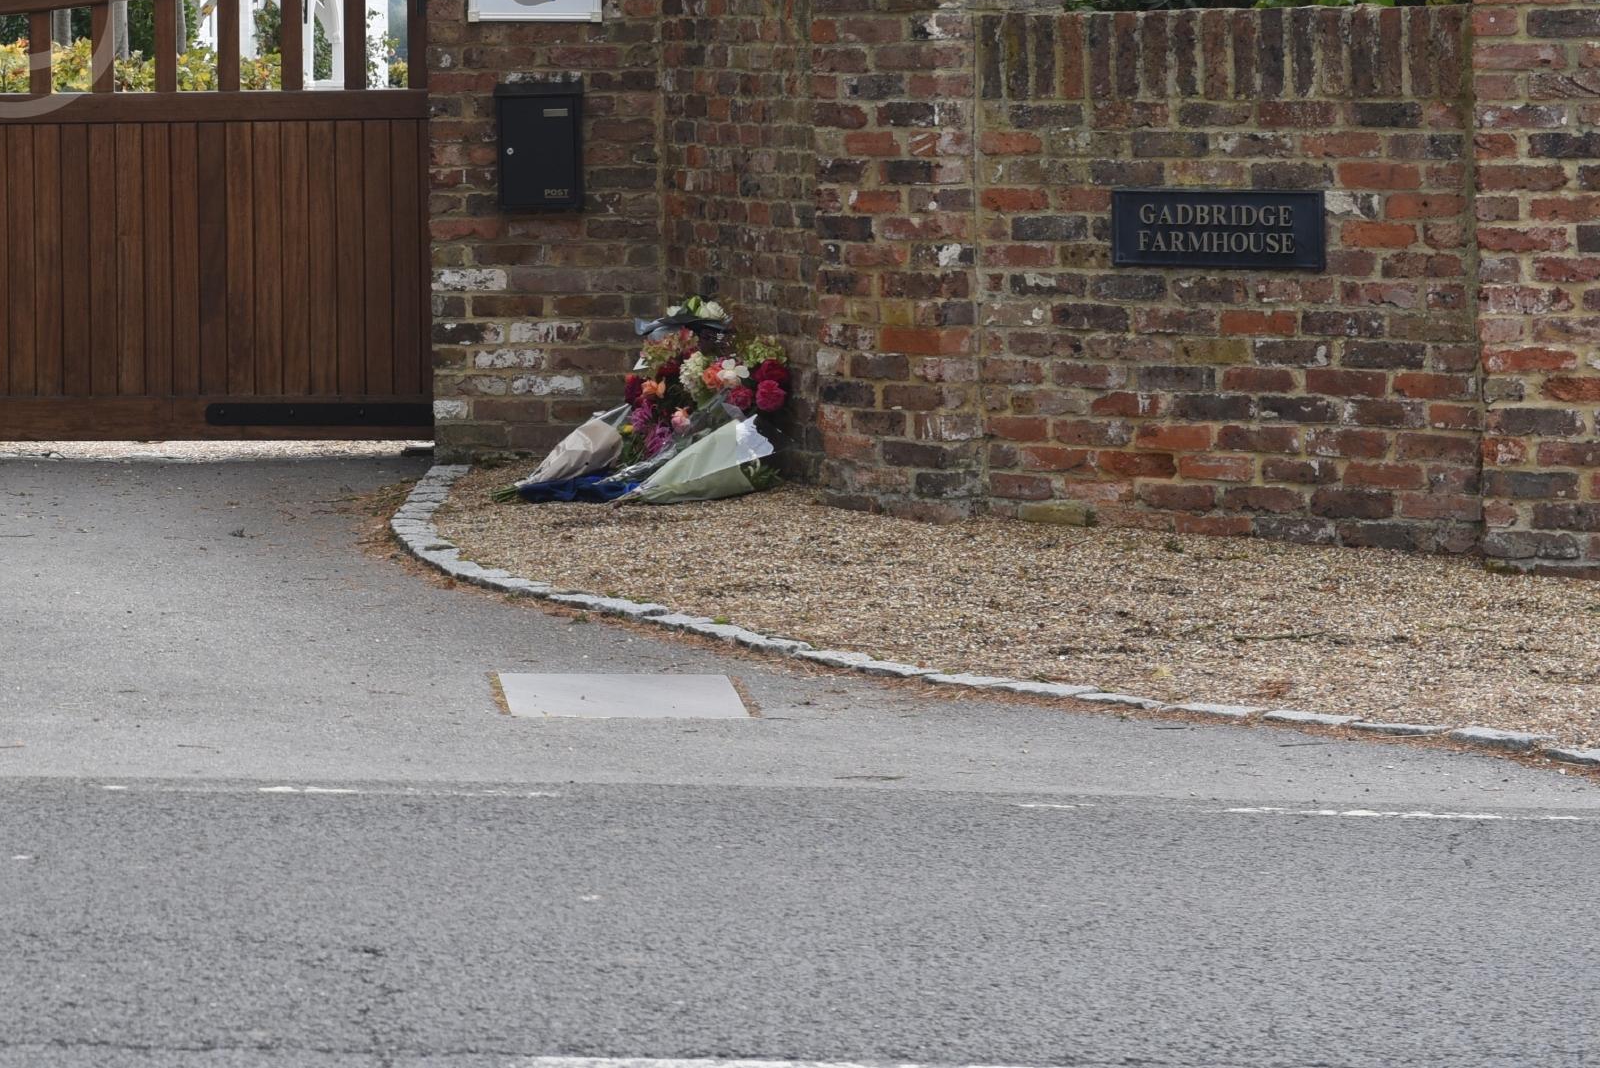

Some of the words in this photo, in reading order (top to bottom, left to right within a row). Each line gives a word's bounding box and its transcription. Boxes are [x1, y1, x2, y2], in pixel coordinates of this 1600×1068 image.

[544, 188, 569, 196] POST
[1139, 203, 1293, 227] GADBRIDGE
[1138, 230, 1296, 254] FARMHOUSE
